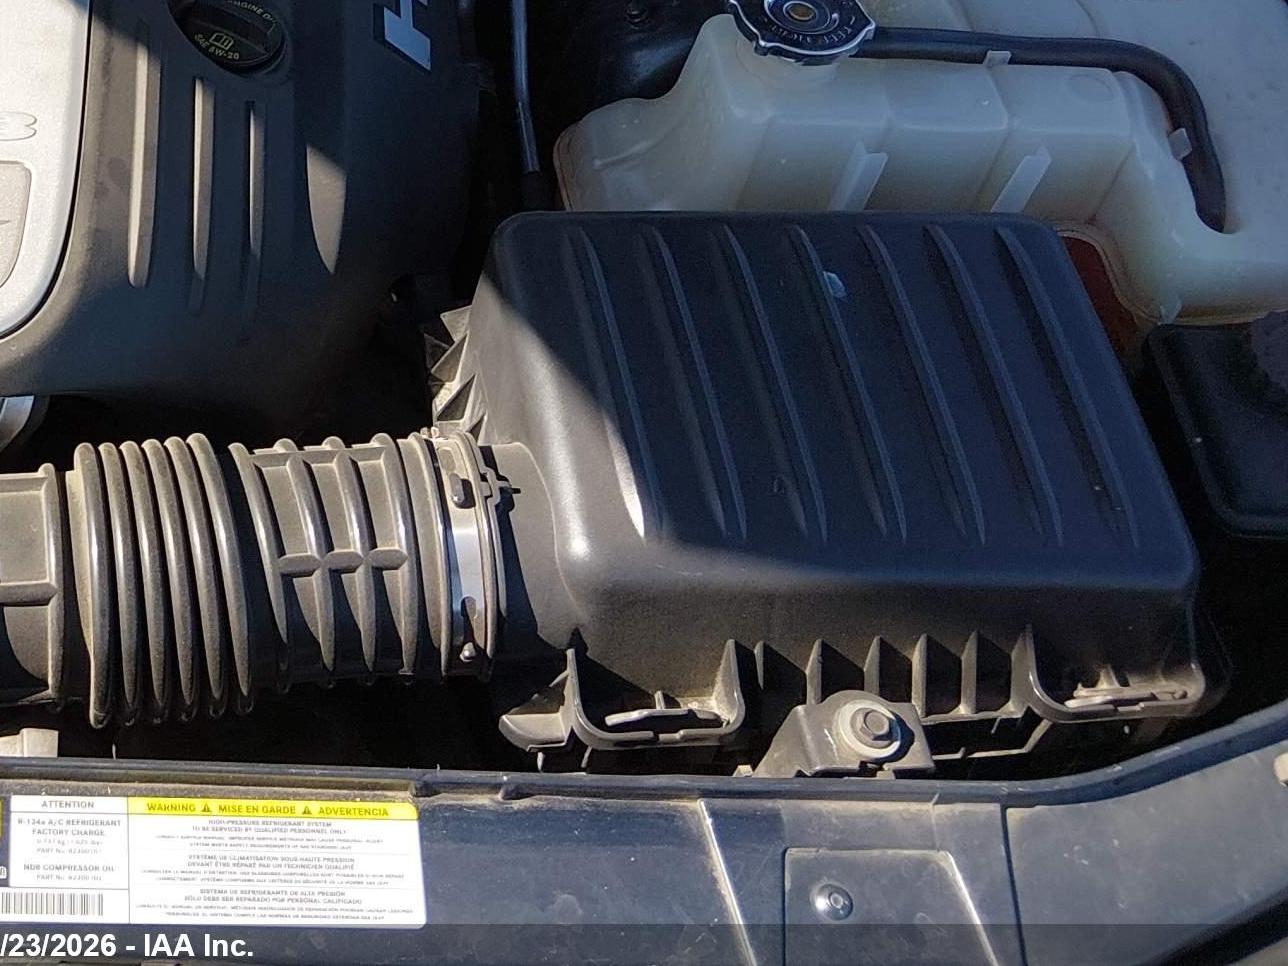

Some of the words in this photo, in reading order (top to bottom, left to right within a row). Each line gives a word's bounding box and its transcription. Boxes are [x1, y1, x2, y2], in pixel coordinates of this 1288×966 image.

[41, 800, 94, 808] ATTENTION
[147, 802, 196, 811] WARNING
[218, 804, 242, 812] MISE
[245, 805, 258, 813] EN
[261, 805, 296, 814] GARDE
[318, 806, 389, 816] ADVERTENCIA
[47, 818, 63, 826] A/C
[65, 818, 120, 826] REFRIGERANT
[31, 827, 68, 835] FACTORY
[71, 828, 104, 836] CHARGE
